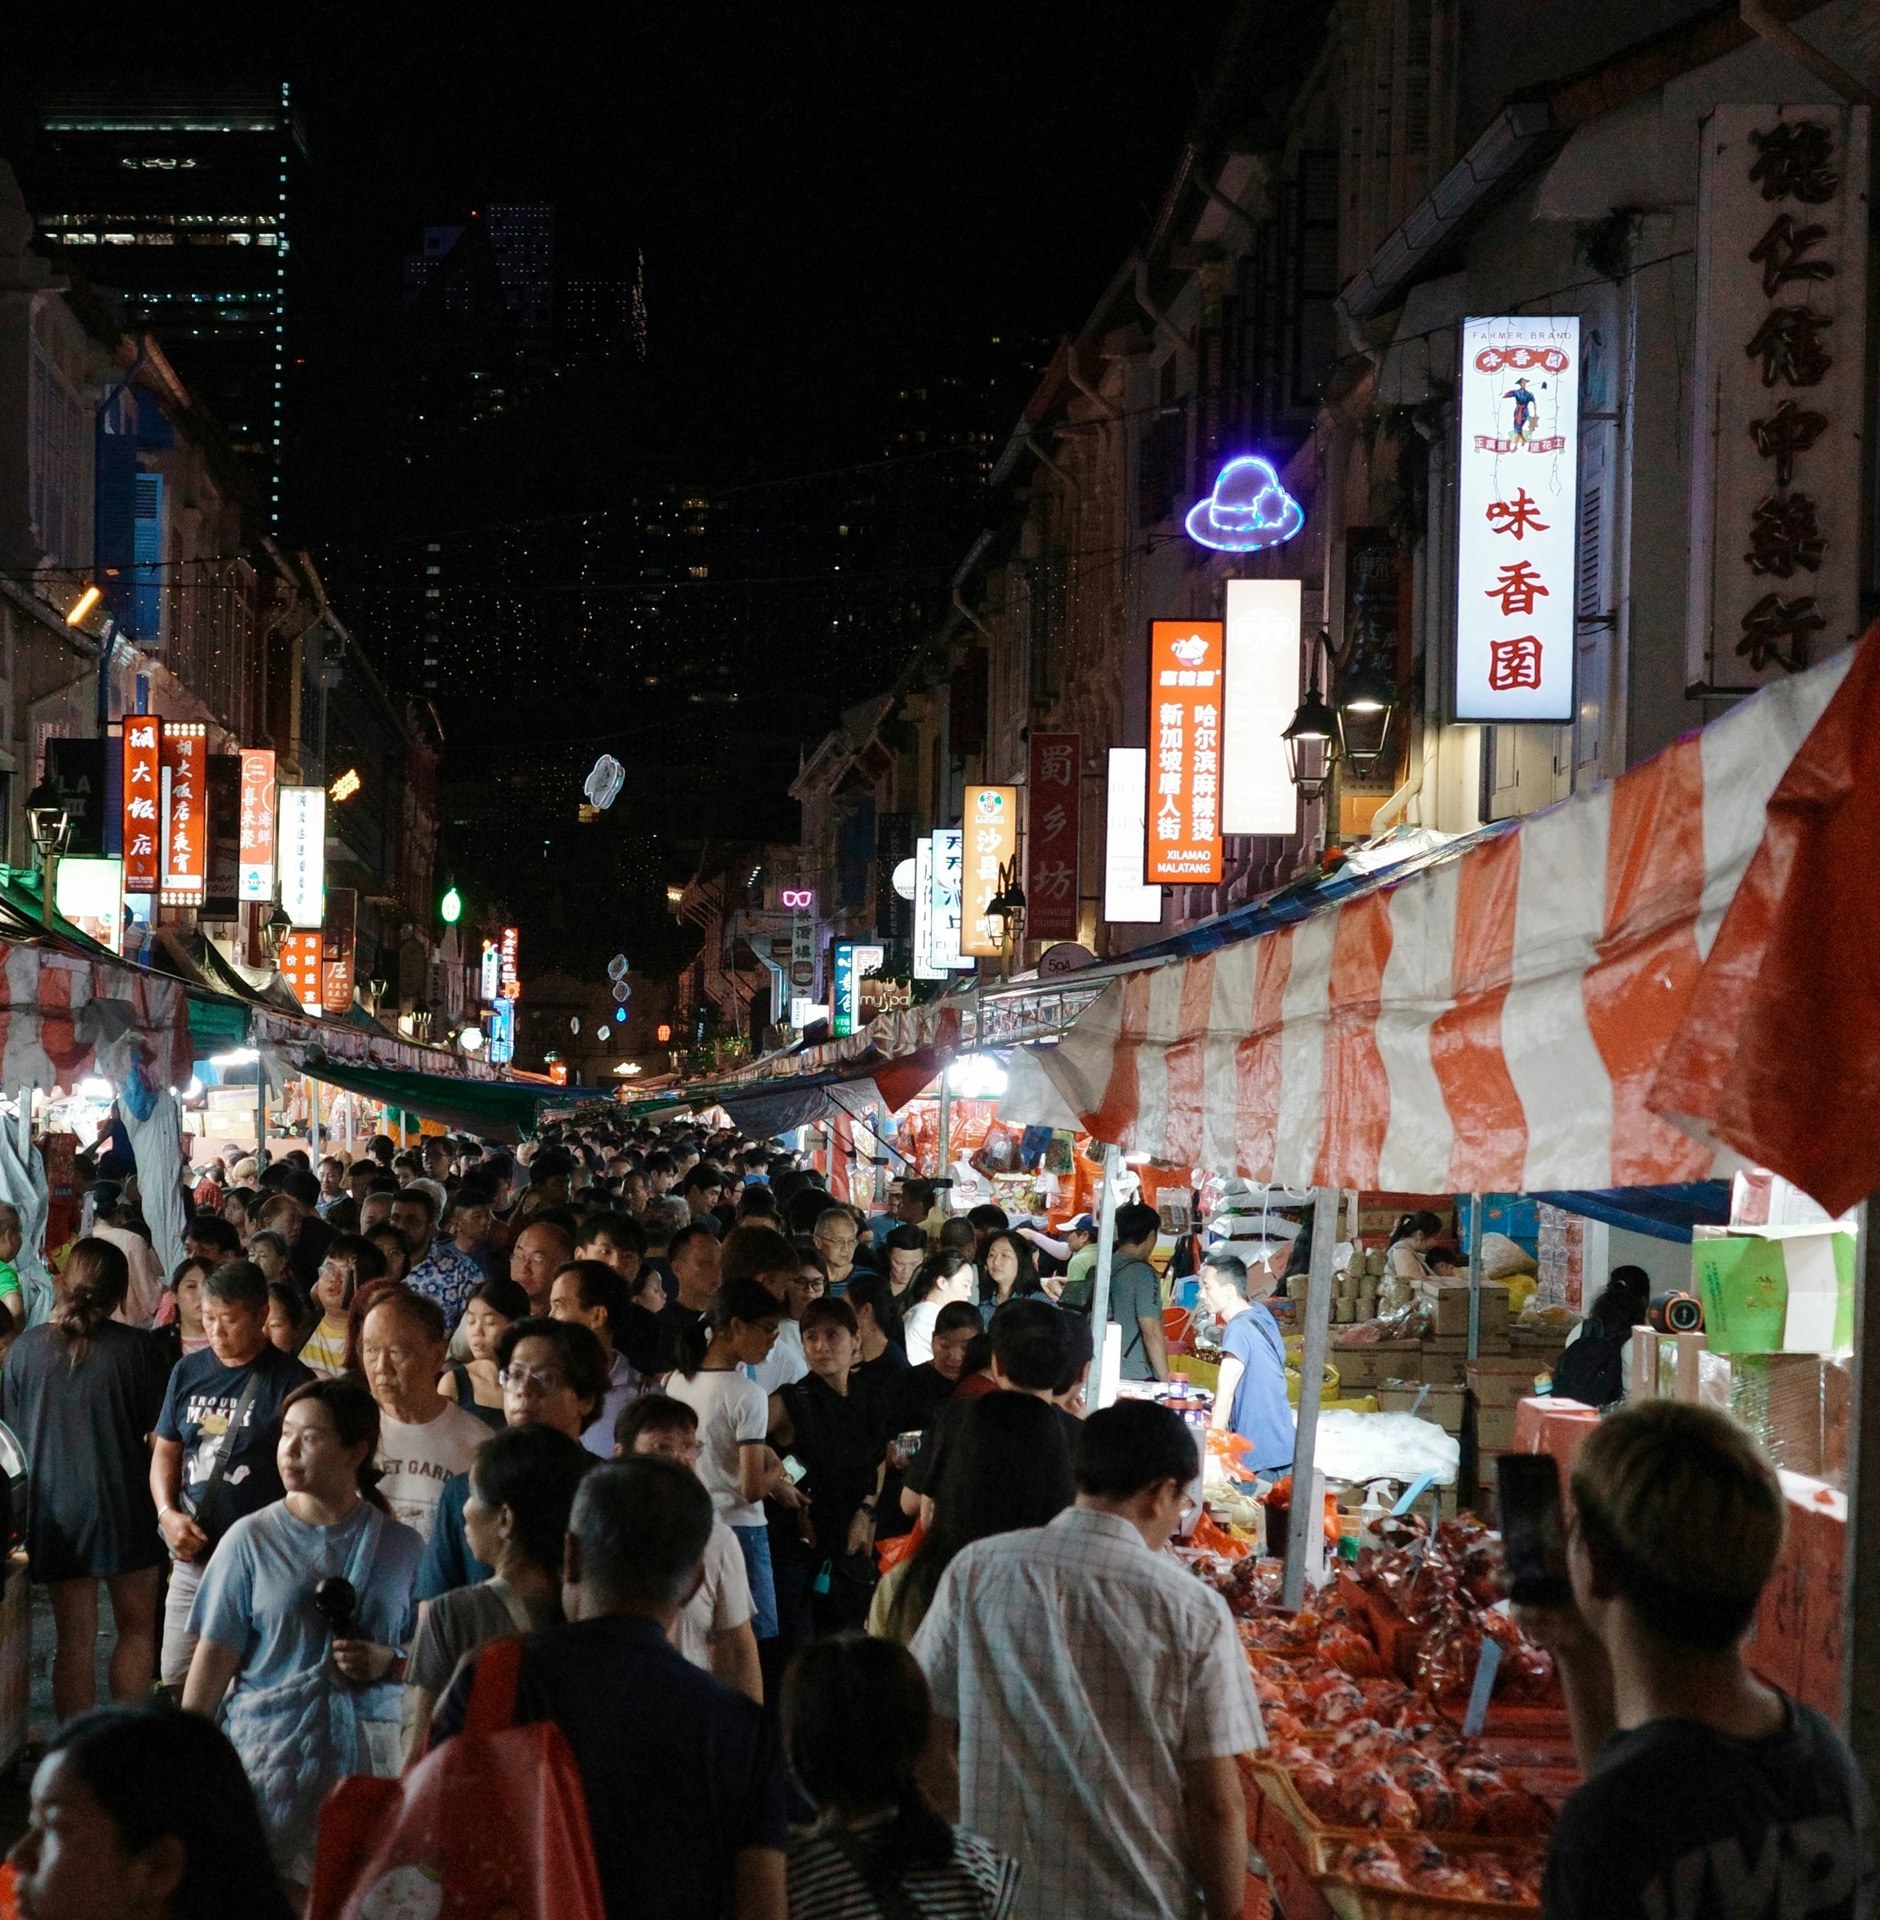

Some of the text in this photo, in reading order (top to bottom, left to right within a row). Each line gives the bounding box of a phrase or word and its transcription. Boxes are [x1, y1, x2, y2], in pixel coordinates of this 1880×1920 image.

[1472, 331, 1572, 340] FARMER BRAND
[1157, 703, 1184, 841] 新加坡唐人街
[1191, 704, 1218, 842] 哈尔滨麻辣烫
[1033, 744, 1074, 902] 蜀乡坊
[1166, 850, 1211, 861] XILAMAO
[1157, 862, 1211, 874] MALATANG
[1033, 907, 1073, 918] CHINESE
[1033, 918, 1072, 929] CUISINE
[189, 1394, 257, 1410] TROUBE
